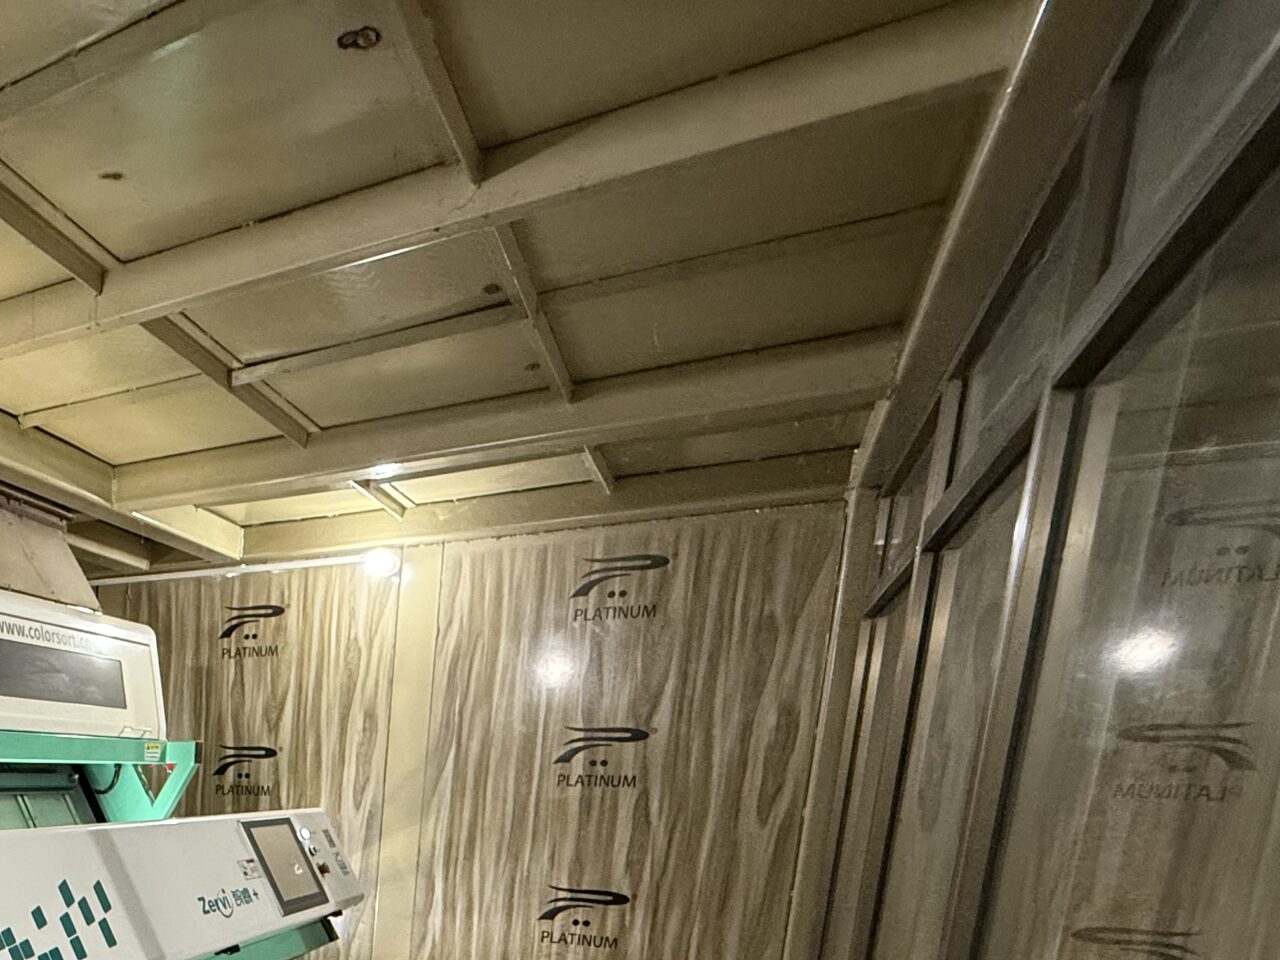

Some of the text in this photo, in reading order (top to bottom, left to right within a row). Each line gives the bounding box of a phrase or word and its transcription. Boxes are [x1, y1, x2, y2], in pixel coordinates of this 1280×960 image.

[574, 604, 657, 621] PLATINUM
[221, 645, 279, 659] PLATINUM
[557, 774, 637, 788] PLATINUM
[215, 784, 271, 796] PLATINUM
[541, 930, 618, 949] PLATINUM
